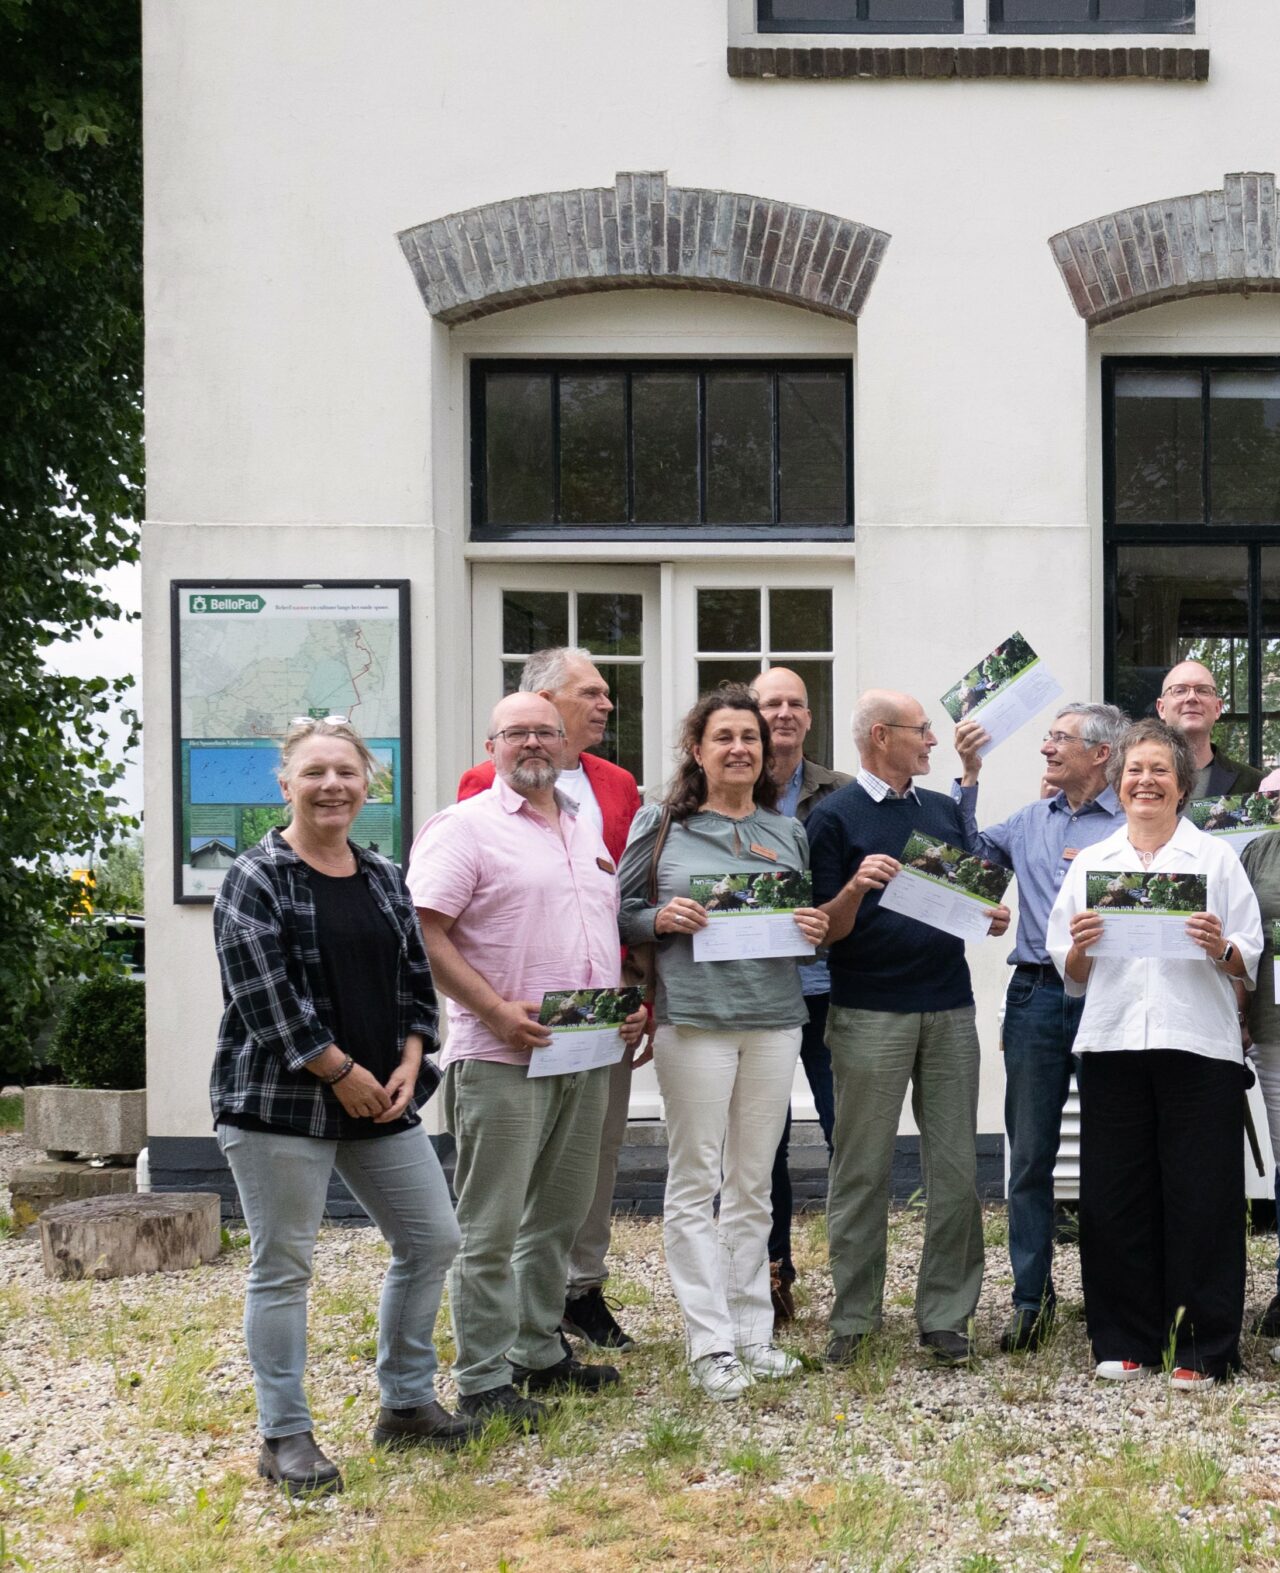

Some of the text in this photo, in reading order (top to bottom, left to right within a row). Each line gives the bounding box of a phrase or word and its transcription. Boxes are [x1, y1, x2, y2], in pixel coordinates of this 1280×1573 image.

[210, 598, 259, 610] BelloPad
[1093, 905, 1120, 913] Diploma
[1133, 906, 1168, 914] Natuurgids
